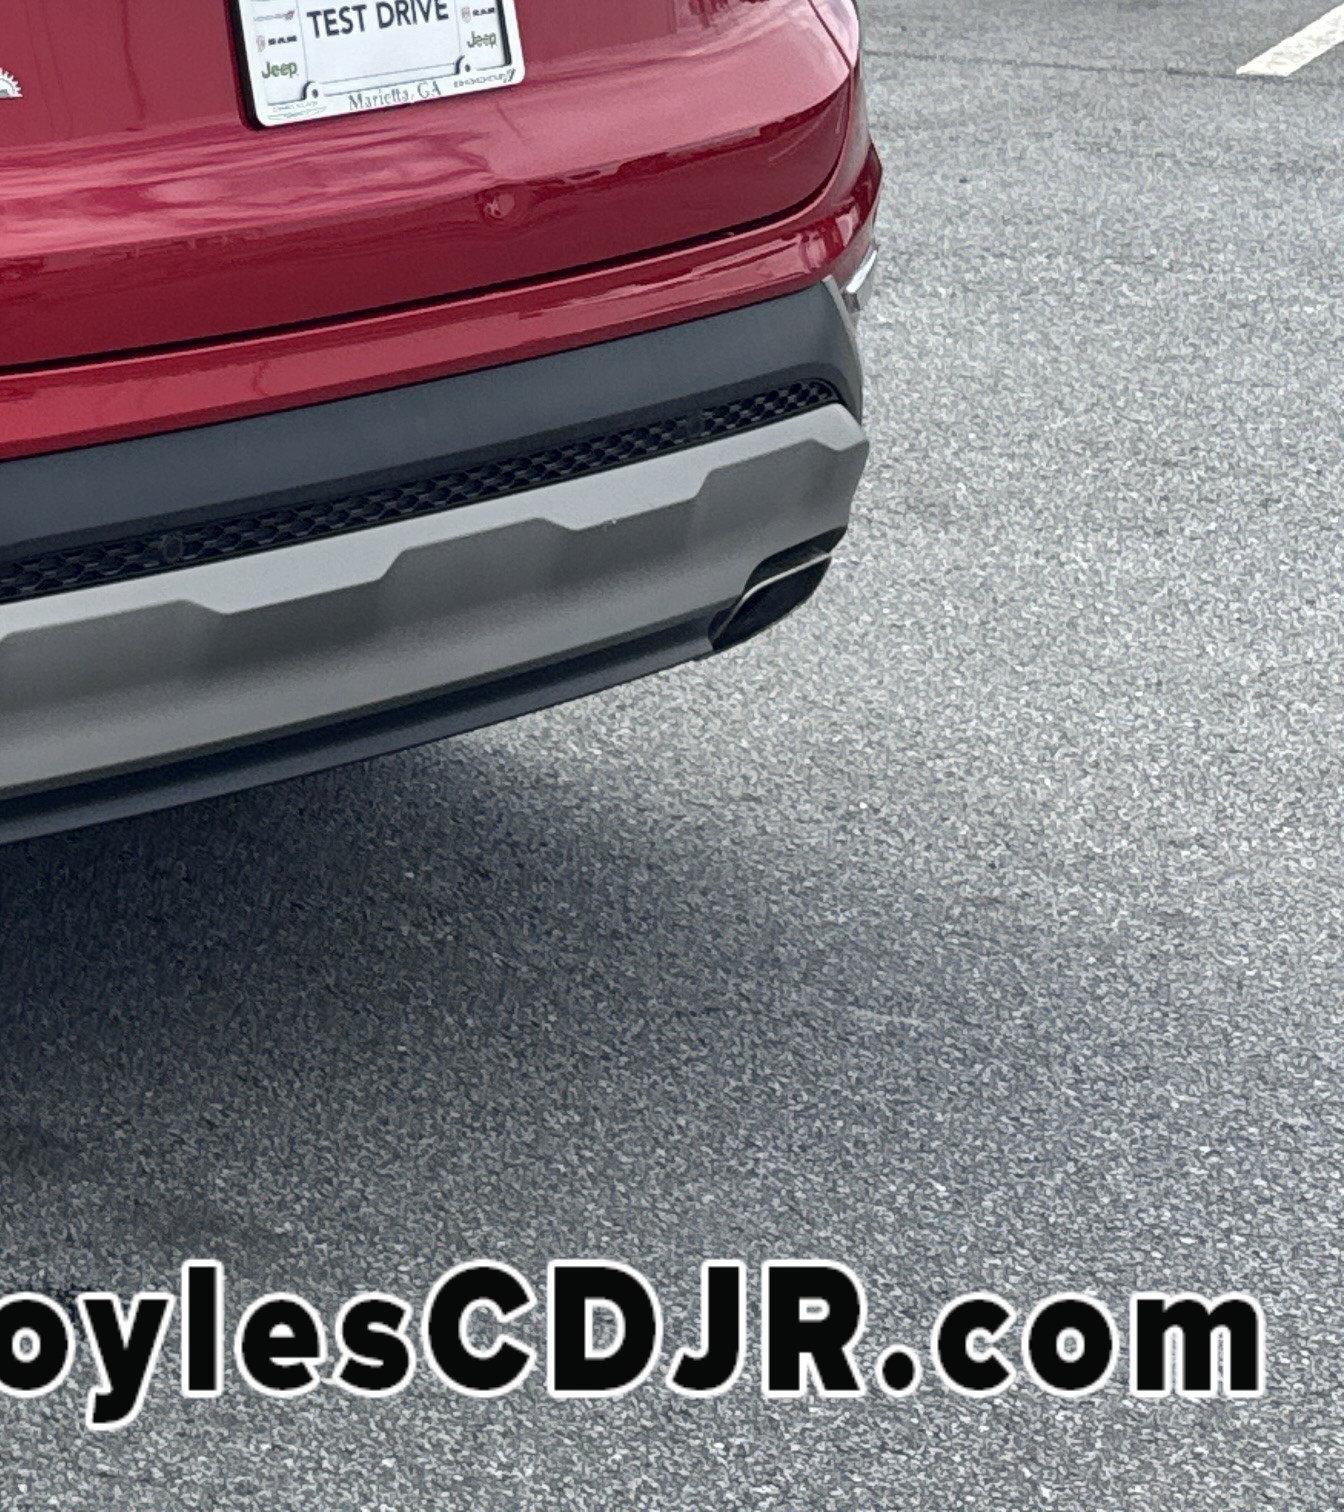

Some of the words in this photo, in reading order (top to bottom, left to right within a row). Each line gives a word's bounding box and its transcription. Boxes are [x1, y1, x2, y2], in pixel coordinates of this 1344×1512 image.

[306, 4, 367, 39] TEST
[466, 30, 496, 48] Jeep
[261, 61, 298, 79] Jeep
[416, 80, 442, 101] GA
